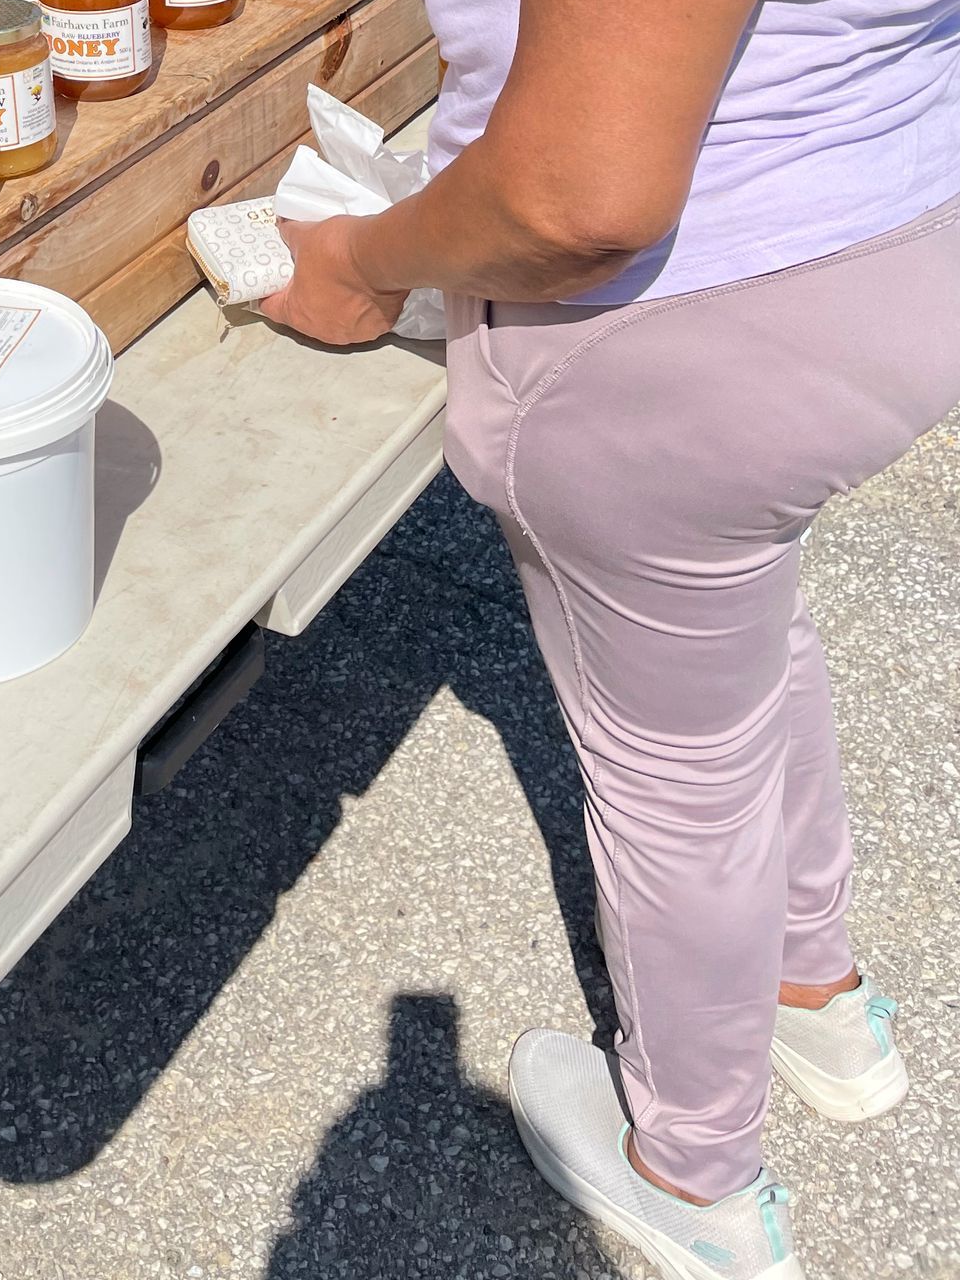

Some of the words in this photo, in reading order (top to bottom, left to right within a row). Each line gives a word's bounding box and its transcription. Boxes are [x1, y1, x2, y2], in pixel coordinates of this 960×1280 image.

[51, 15, 100, 31] Fairhaven
[103, 17, 129, 27] Farm
[77, 31, 121, 40] BLUEBERRY
